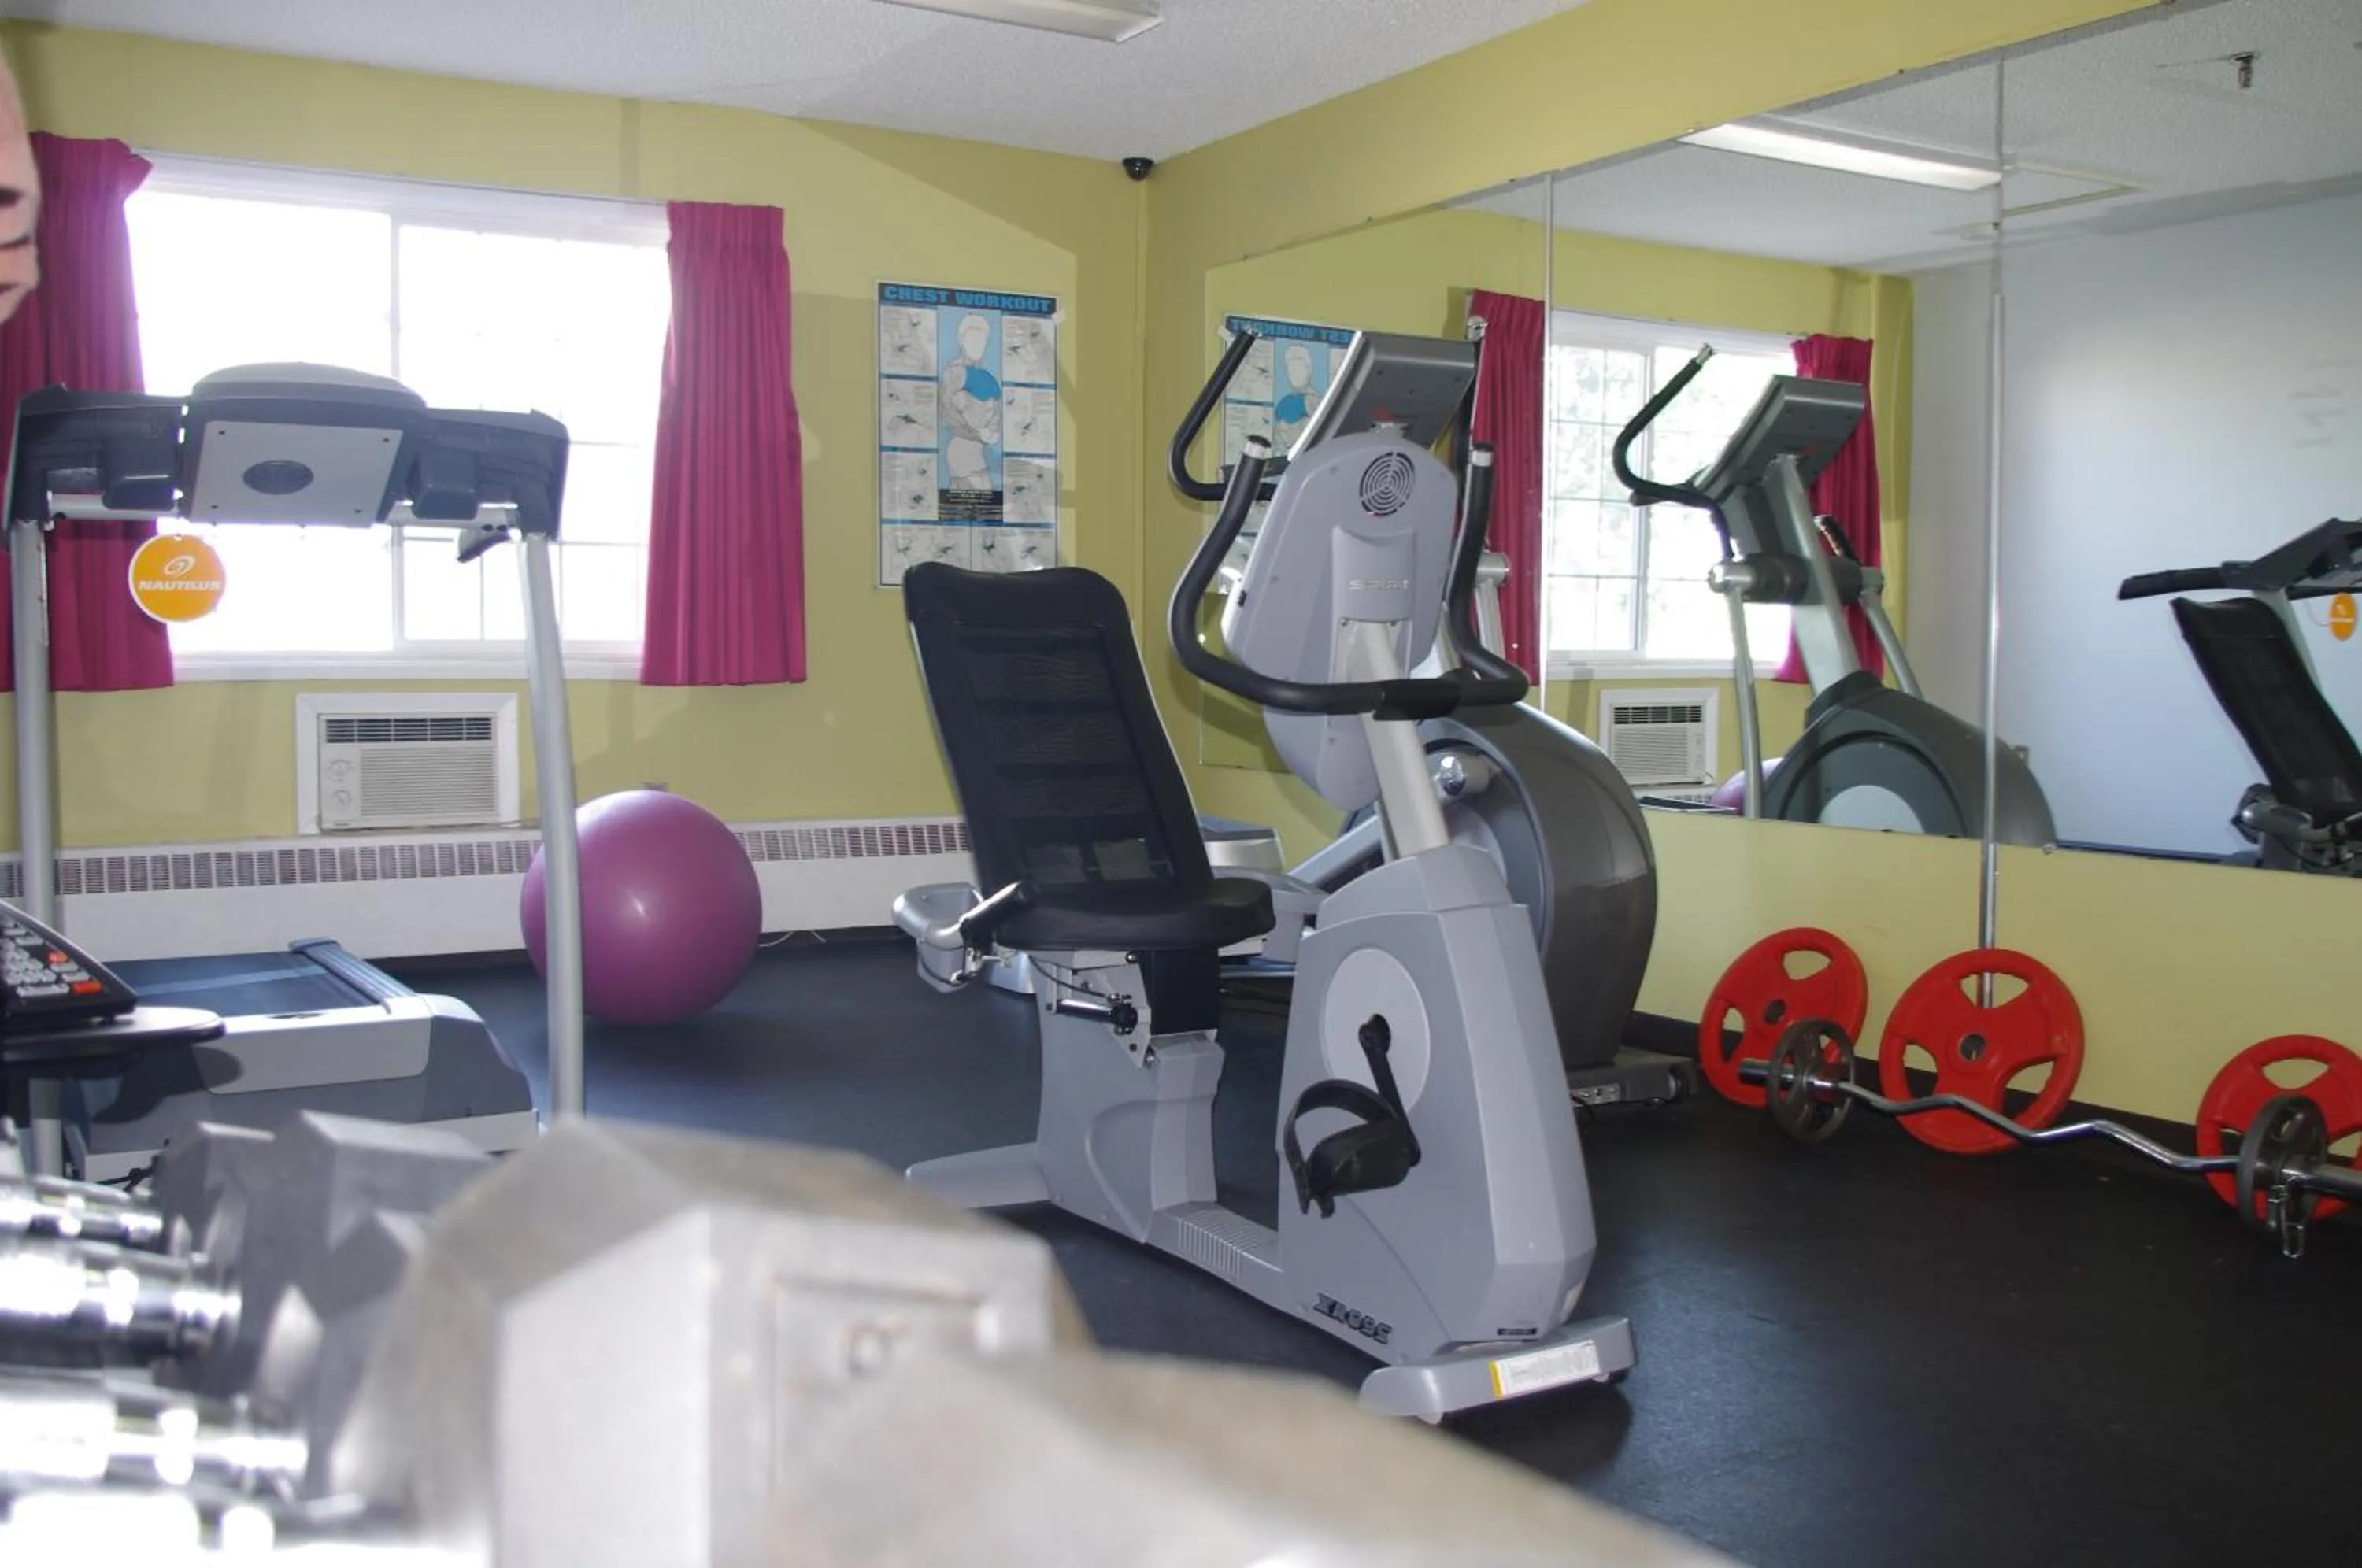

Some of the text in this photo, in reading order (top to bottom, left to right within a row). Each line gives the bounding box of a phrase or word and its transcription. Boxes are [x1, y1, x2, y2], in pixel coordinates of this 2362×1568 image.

[883, 286, 1052, 312] CHEST WORKOUT
[139, 580, 221, 590] NAUTILUS
